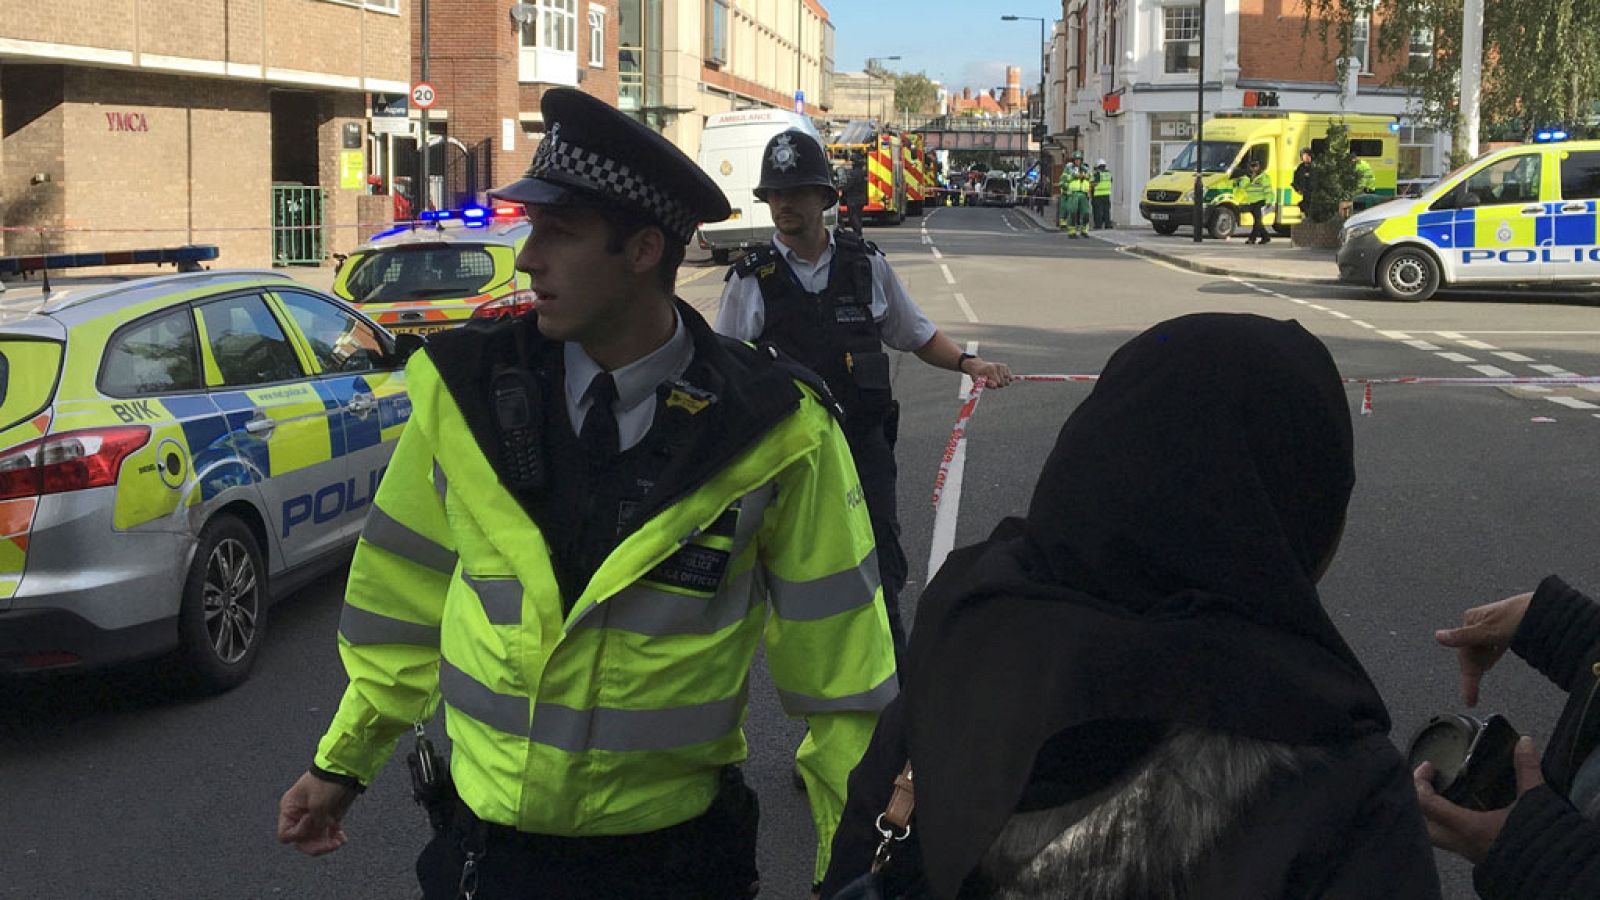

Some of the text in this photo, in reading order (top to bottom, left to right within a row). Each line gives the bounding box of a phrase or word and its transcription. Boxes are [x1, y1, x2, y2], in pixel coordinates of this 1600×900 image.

[414, 90, 432, 101] 20
[105, 111, 149, 132] YMCA
[721, 113, 771, 123] AMBULANCE
[1462, 247, 1600, 265] POLI
[111, 399, 160, 423] BVK
[282, 464, 388, 540] POLI
